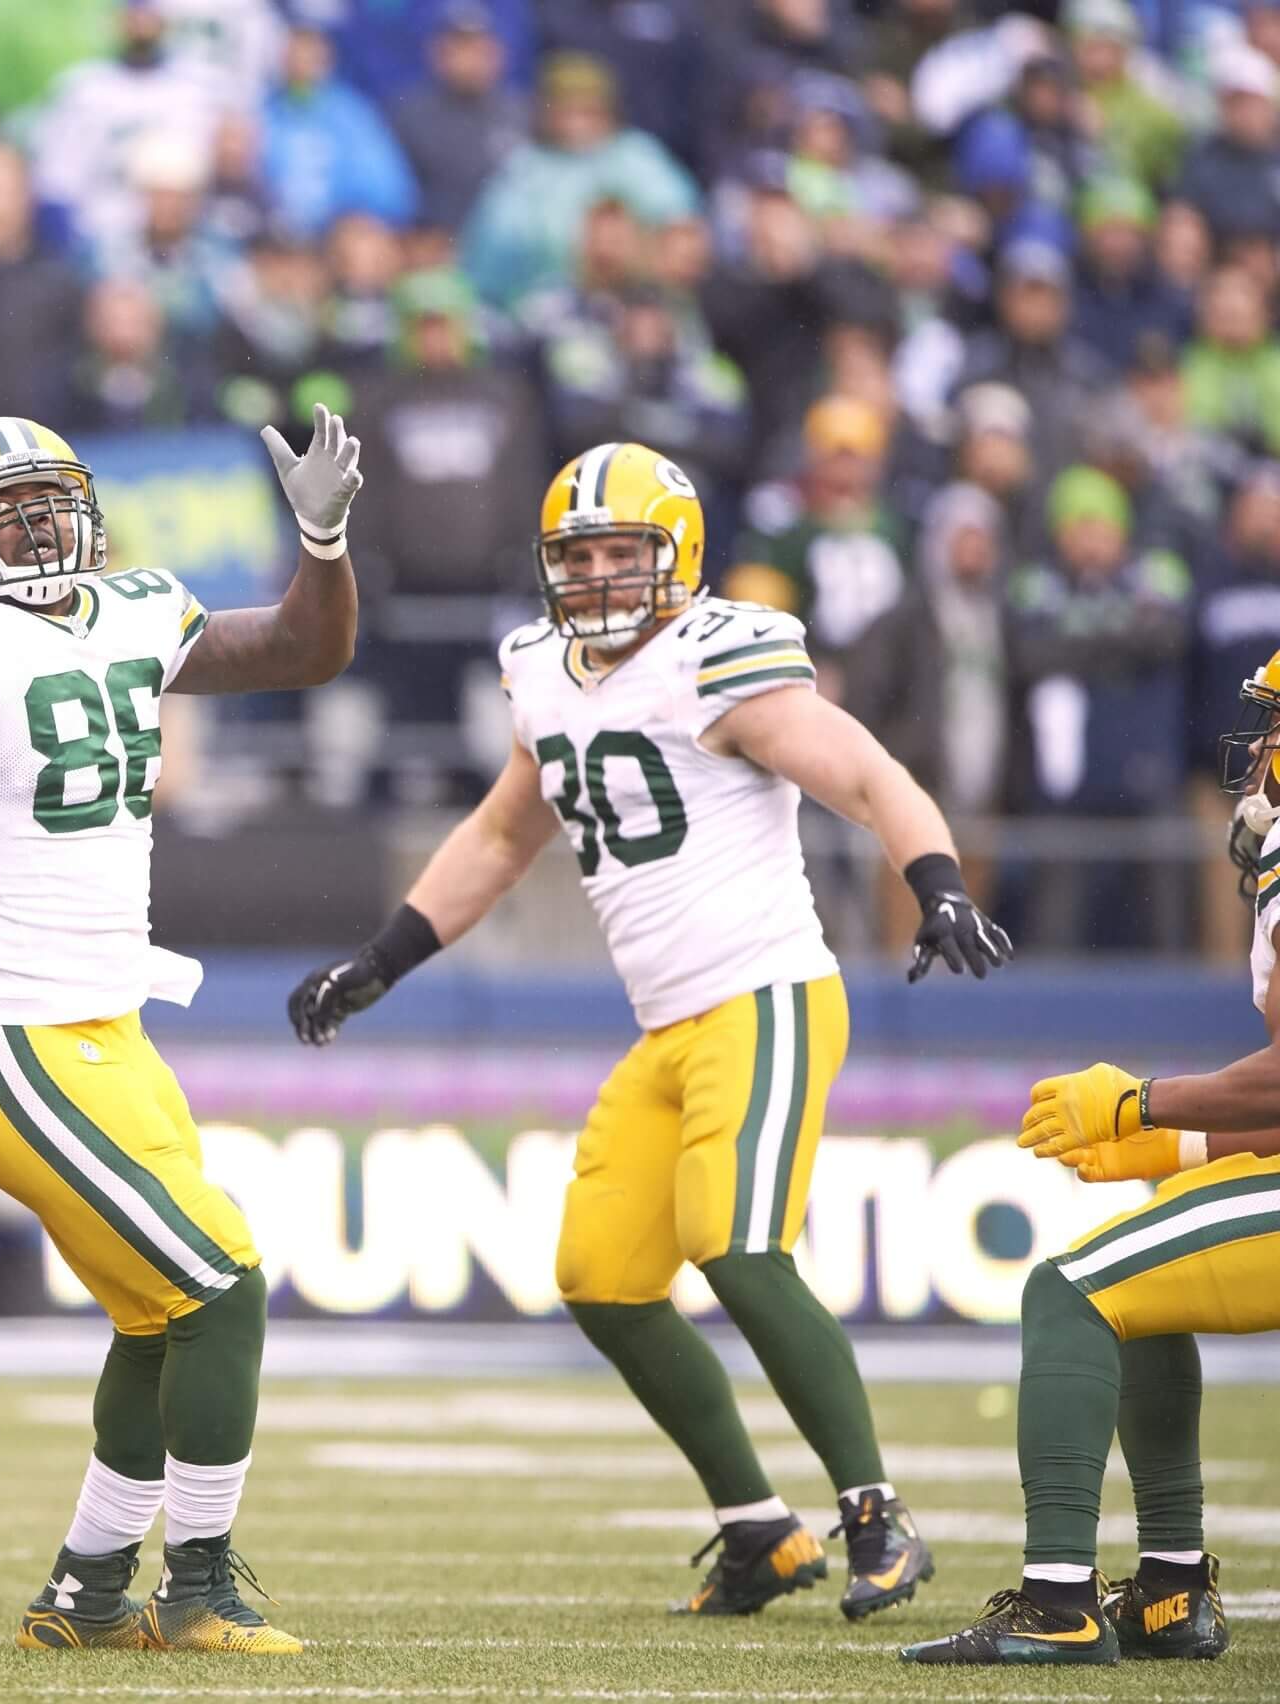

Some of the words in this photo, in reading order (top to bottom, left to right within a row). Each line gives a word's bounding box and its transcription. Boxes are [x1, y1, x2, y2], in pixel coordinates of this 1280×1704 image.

[24, 657, 164, 833] 86
[535, 730, 687, 876] 30
[1143, 1591, 1190, 1636] NIKE
